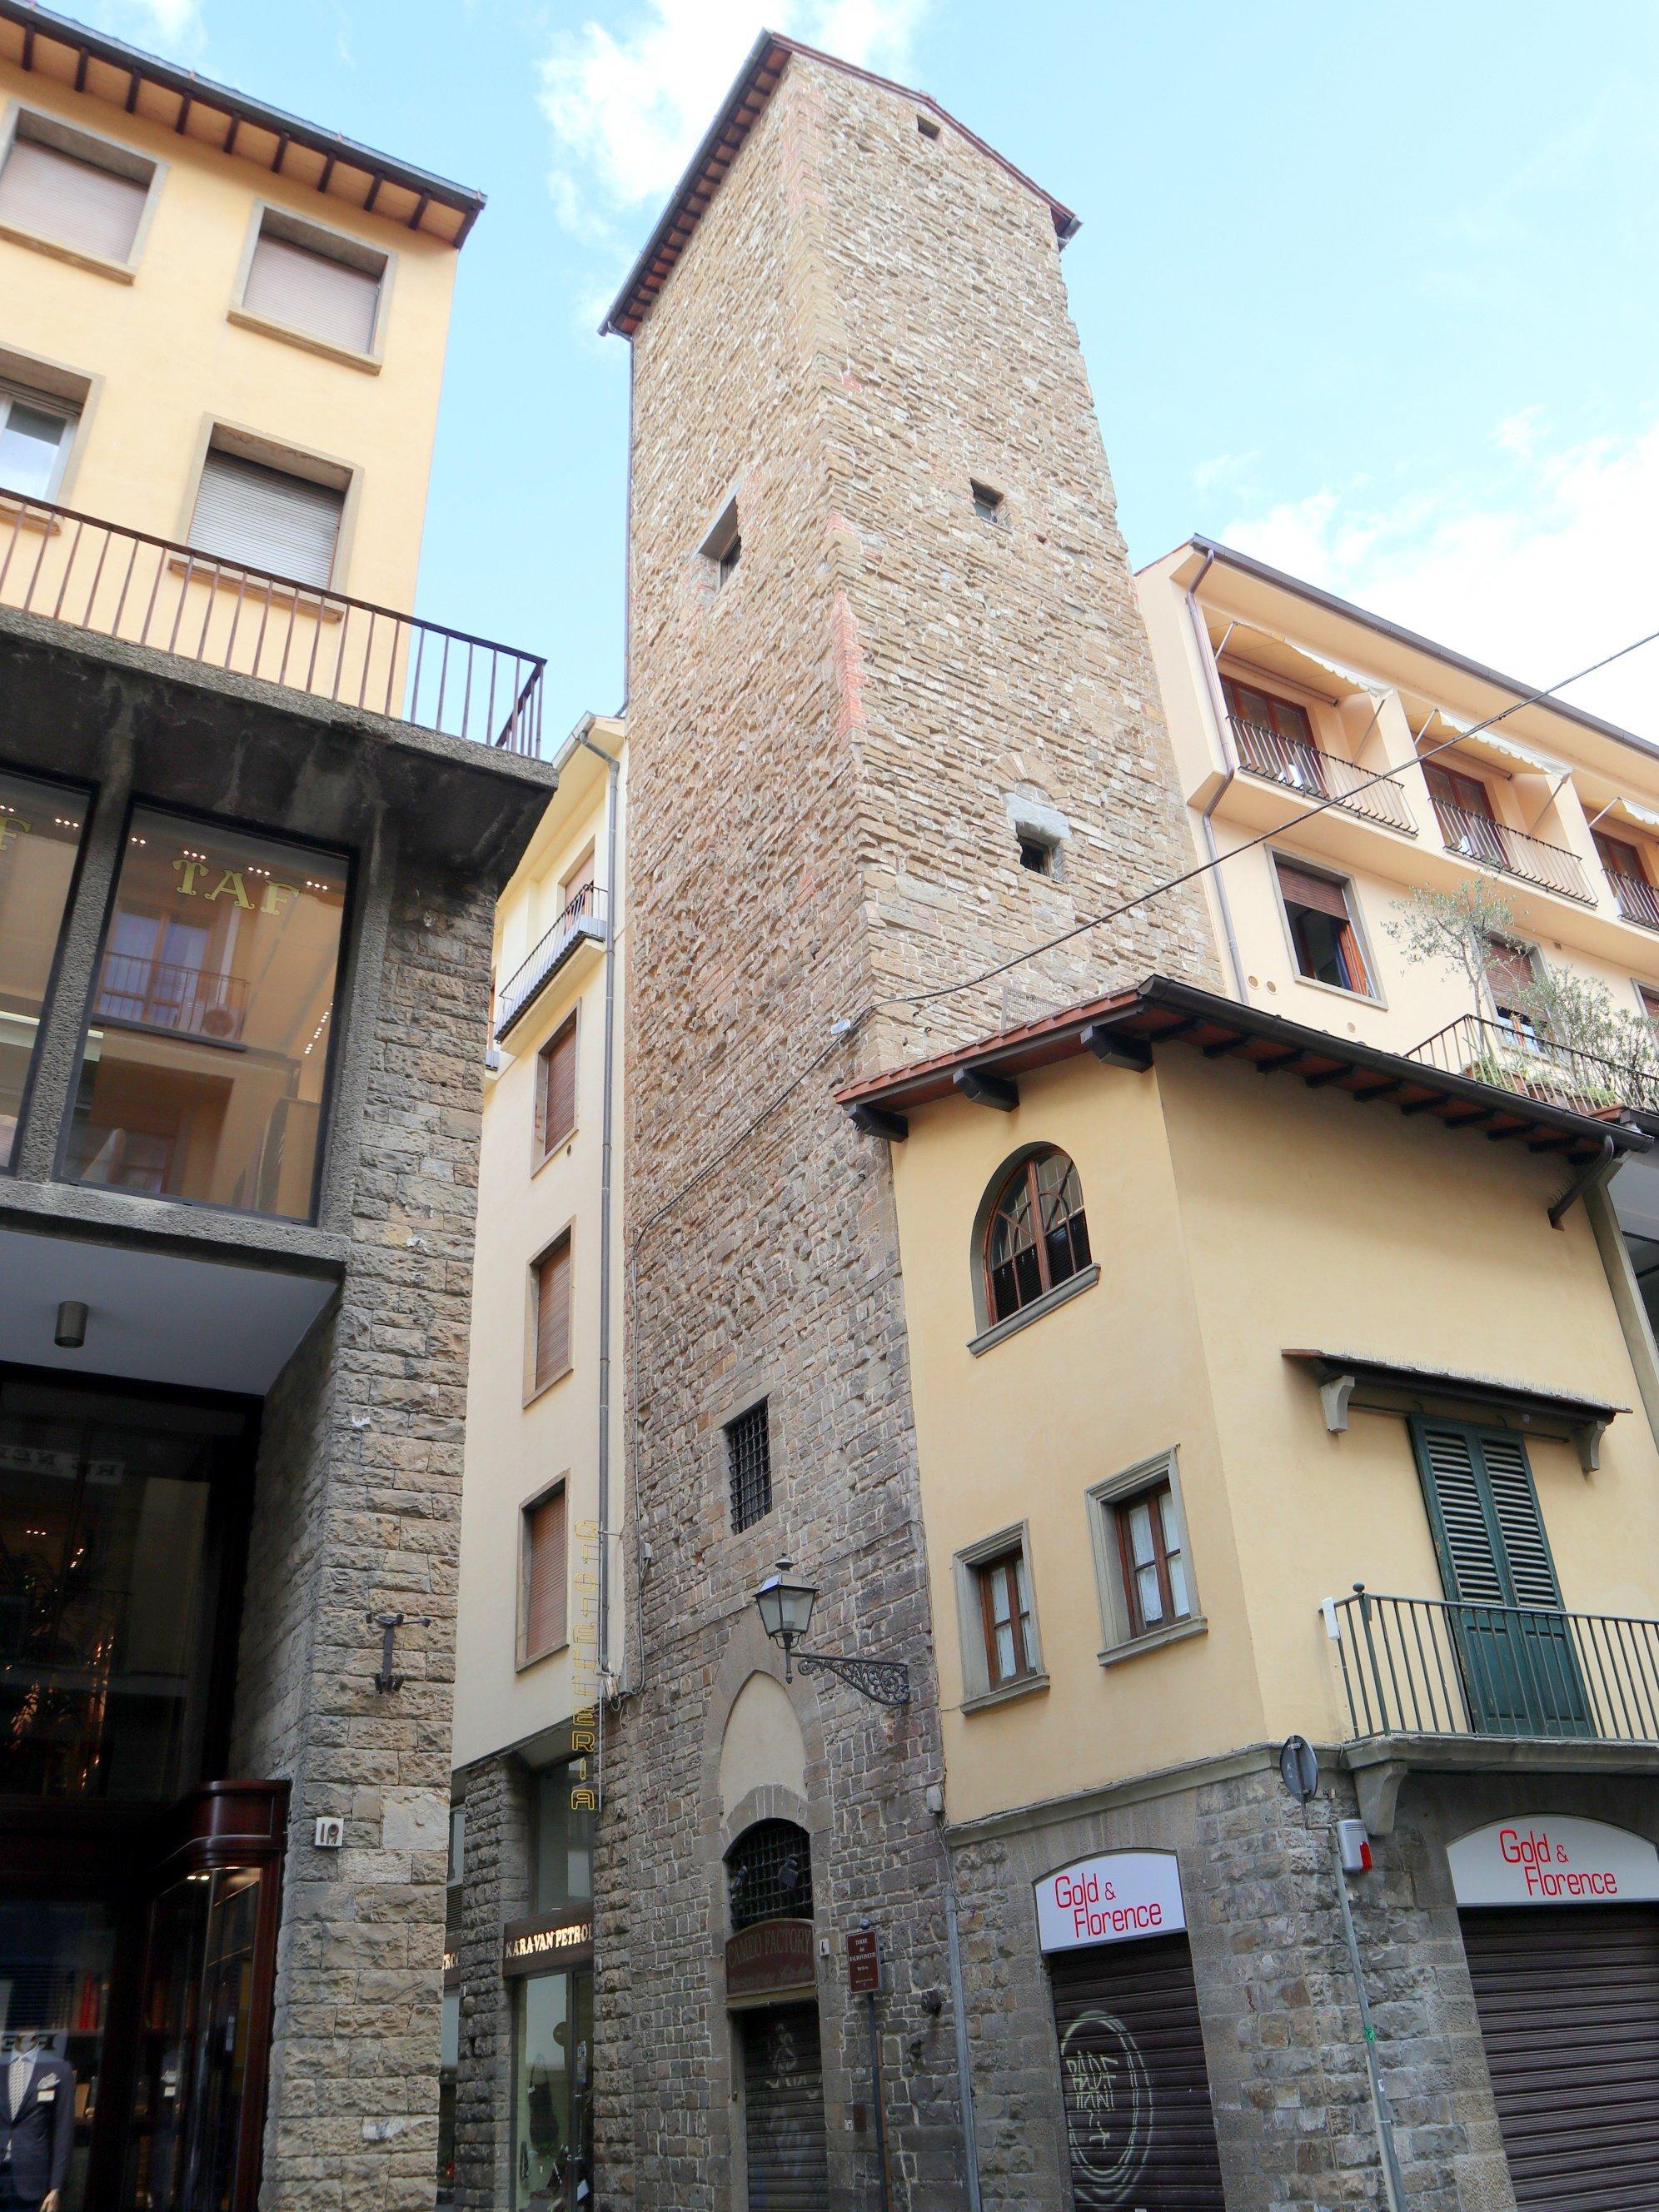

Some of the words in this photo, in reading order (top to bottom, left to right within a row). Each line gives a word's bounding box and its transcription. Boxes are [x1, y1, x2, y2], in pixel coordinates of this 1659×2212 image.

[172, 858, 301, 915] TAF
[1499, 1829, 1551, 1864] Gold
[1557, 1845, 1569, 1863] &
[1054, 1872, 1099, 1908] Gold
[1104, 1881, 1116, 1901] &
[1524, 1866, 1618, 1896] Florence
[1074, 1902, 1162, 1938] Florence
[505, 1931, 554, 1959] KARAVAN
[765, 1928, 811, 1954] FACTORY
